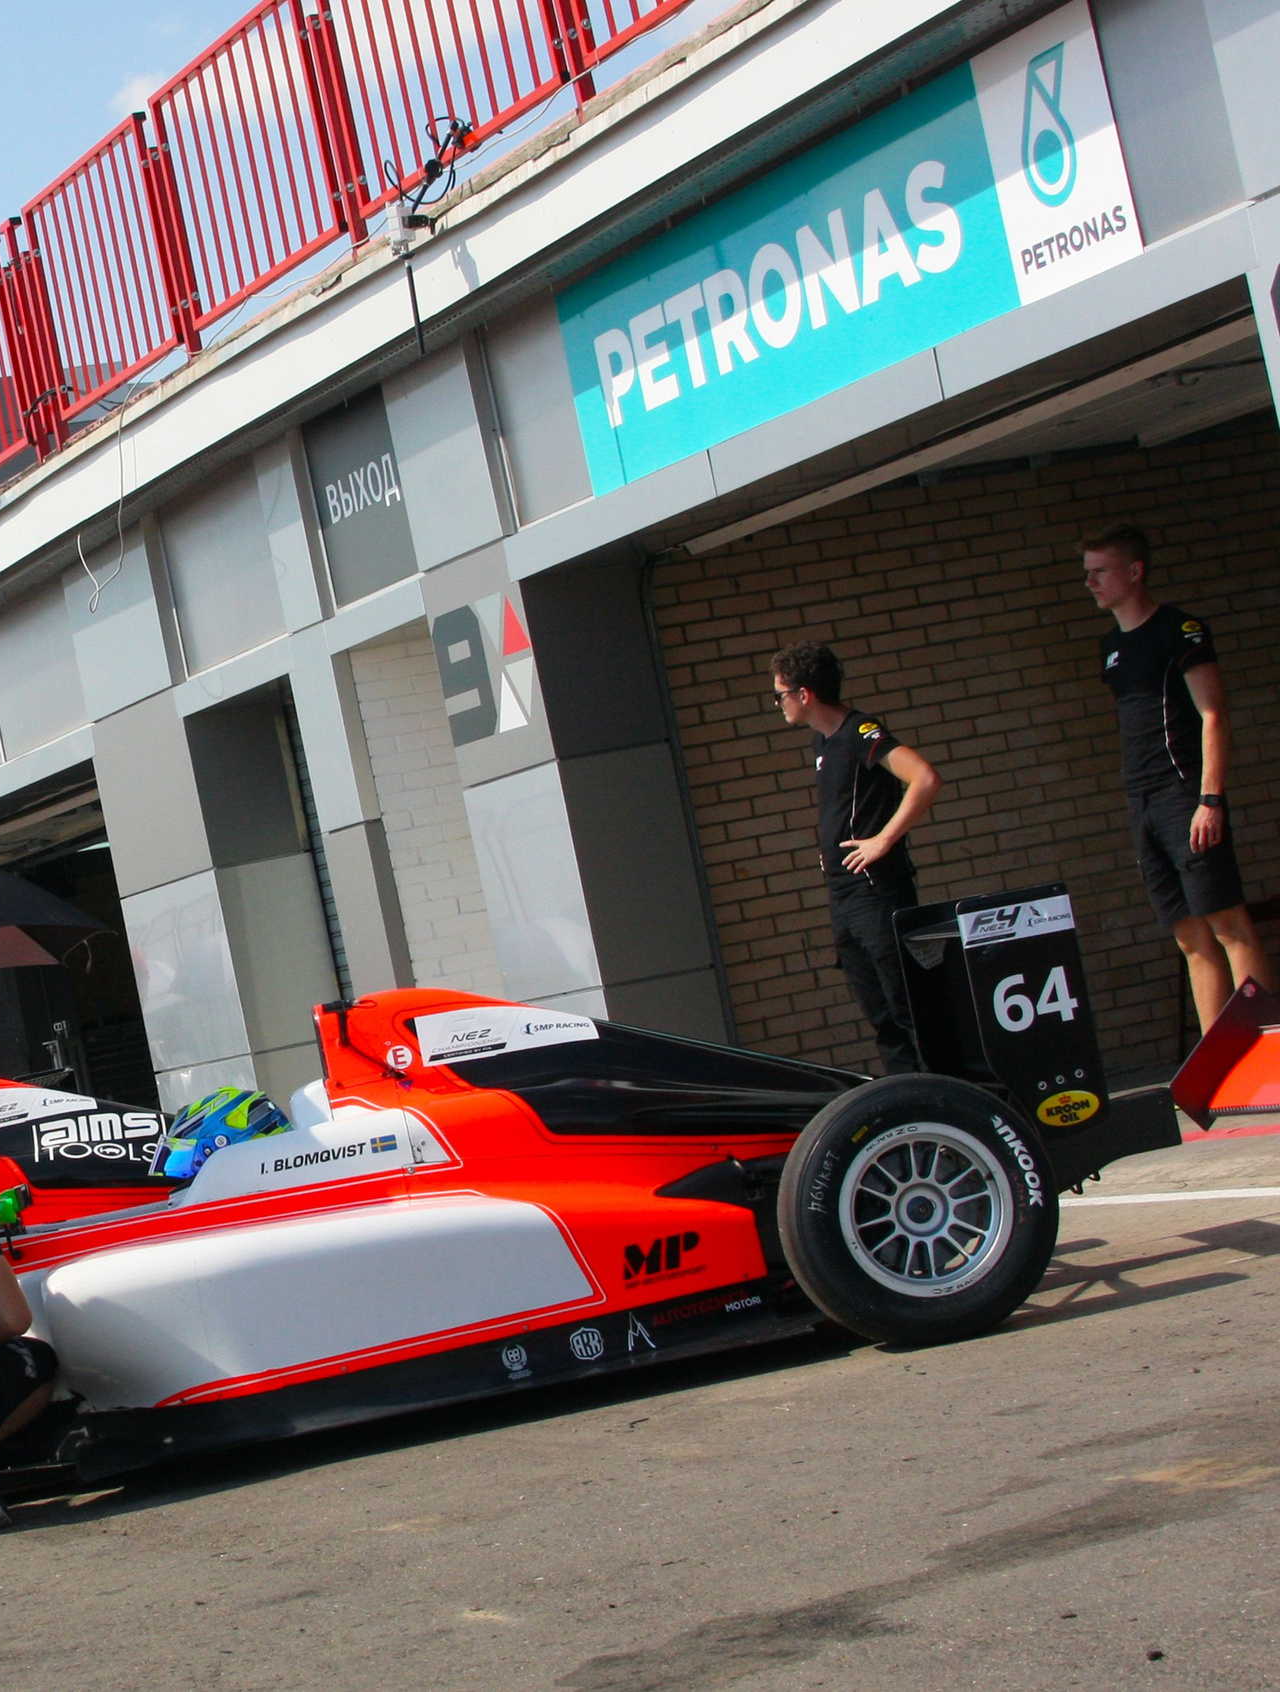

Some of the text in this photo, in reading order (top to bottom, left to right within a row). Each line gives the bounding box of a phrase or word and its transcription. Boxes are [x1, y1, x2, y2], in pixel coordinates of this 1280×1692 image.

[1020, 205, 1127, 275] PETRONAS
[593, 159, 963, 429] PETRONAS
[325, 453, 401, 525] ВЫХОД
[432, 605, 498, 747] 9
[969, 906, 1022, 934] F4
[980, 923, 1006, 933] NEZ
[1048, 913, 1071, 921] RACING
[993, 965, 1079, 1032] 64
[450, 1028, 491, 1043] NEZ
[534, 1023, 554, 1032] SMP
[392, 1047, 407, 1066] E
[1046, 1099, 1091, 1117] KROON
[1059, 1112, 1079, 1123] OIL
[41, 1143, 158, 1162] TOOLS
[274, 1142, 366, 1173] BLOMQVIST
[990, 1114, 1043, 1207] anKOOK
[624, 1231, 700, 1280] MP
[725, 1295, 761, 1312] MOTORI
